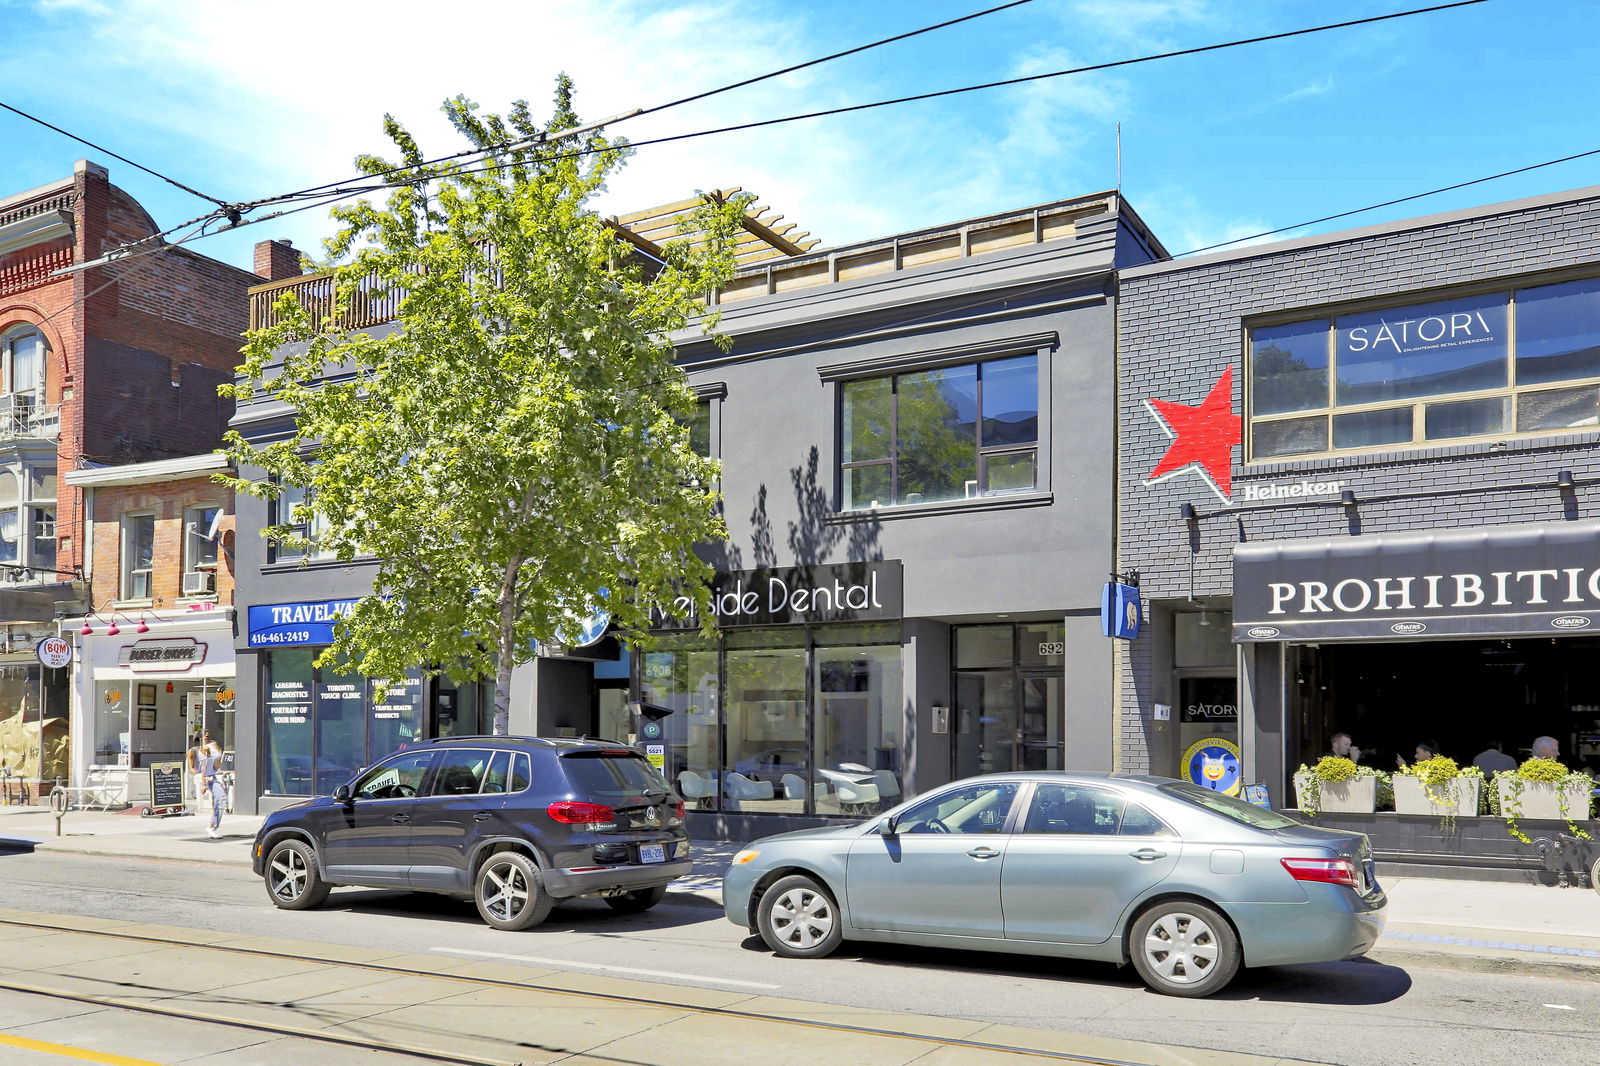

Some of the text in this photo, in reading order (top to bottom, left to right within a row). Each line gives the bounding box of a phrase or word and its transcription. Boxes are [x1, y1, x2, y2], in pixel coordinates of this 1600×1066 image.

[1349, 311, 1490, 353] SATORI
[1458, 336, 1494, 346] EXPERIENCES
[1244, 481, 1345, 501] Heineken
[768, 571, 882, 614] Dental
[271, 604, 333, 624] TRAVEL
[251, 631, 309, 644] 416-461-2419
[47, 643, 67, 654] BQM
[1040, 643, 1062, 655] 692
[272, 691, 308, 699] DIAGNOSTICS
